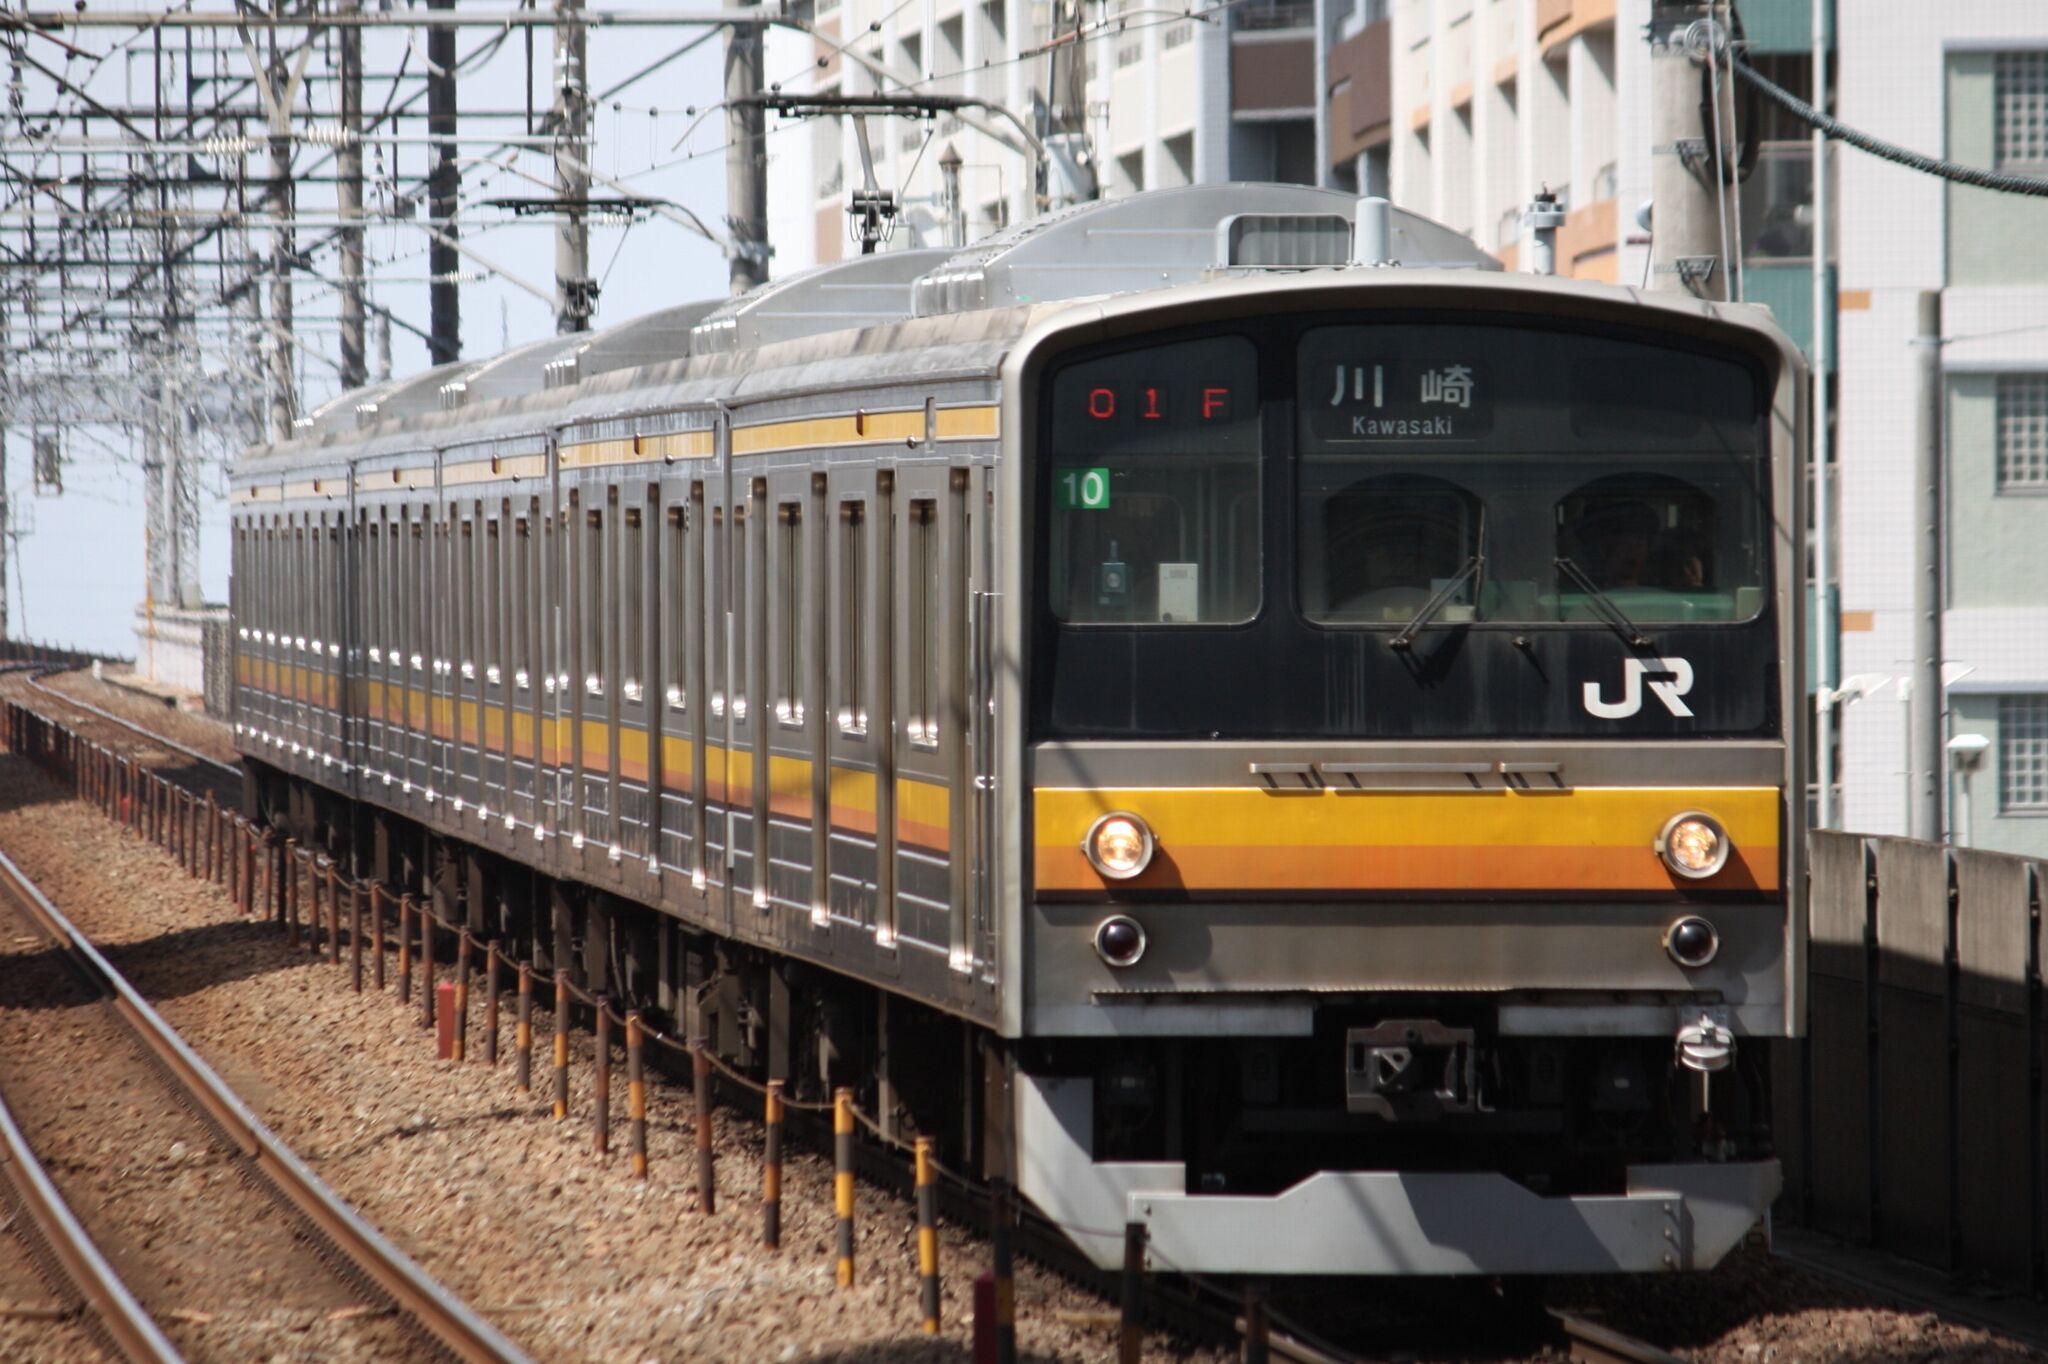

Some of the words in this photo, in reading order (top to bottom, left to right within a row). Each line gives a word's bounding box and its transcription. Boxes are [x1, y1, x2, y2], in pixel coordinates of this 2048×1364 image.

[1330, 364, 1475, 408] 川崎
[1352, 415, 1453, 435] Kawasaki
[1062, 471, 1104, 506] 10
[1583, 656, 1695, 719] JR
